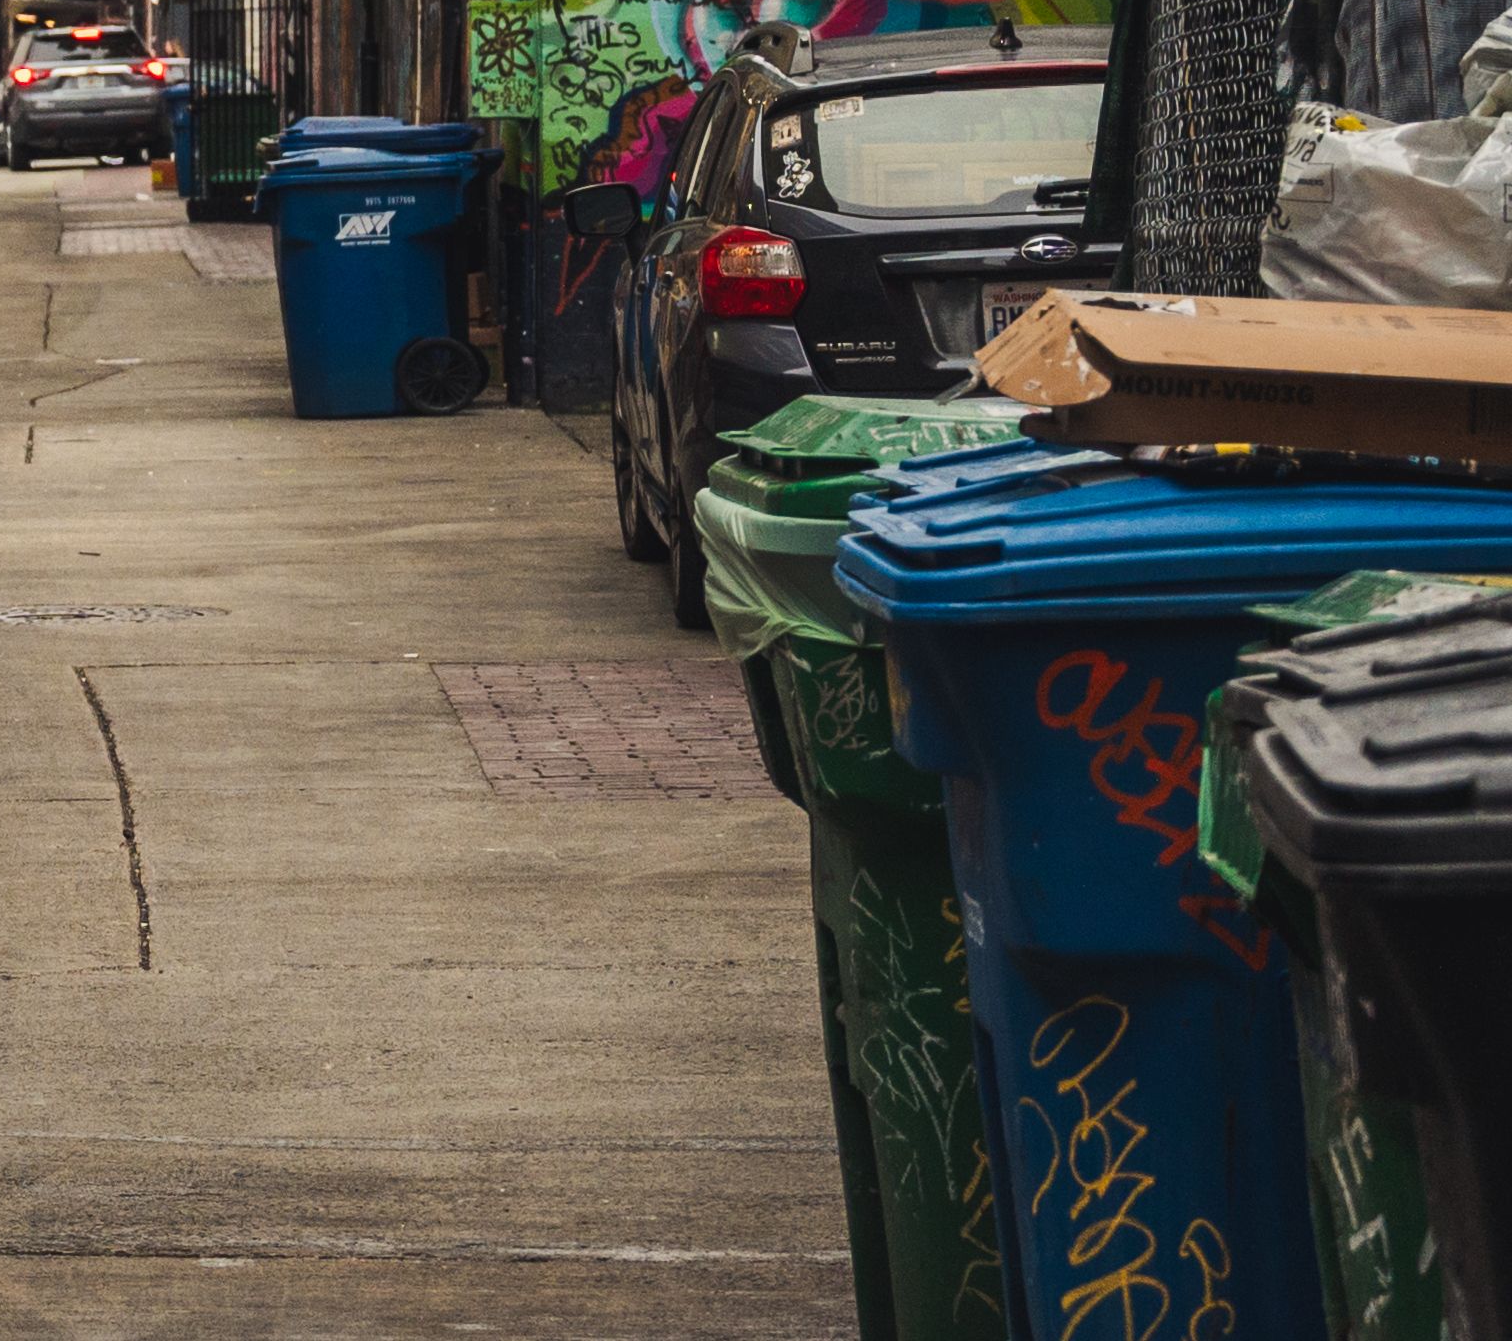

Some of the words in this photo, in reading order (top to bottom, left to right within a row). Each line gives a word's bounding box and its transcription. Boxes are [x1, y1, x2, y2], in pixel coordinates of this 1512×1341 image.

[569, 15, 642, 51] THIS
[993, 292, 1042, 303] WASHING
[816, 341, 896, 351] SUBARU
